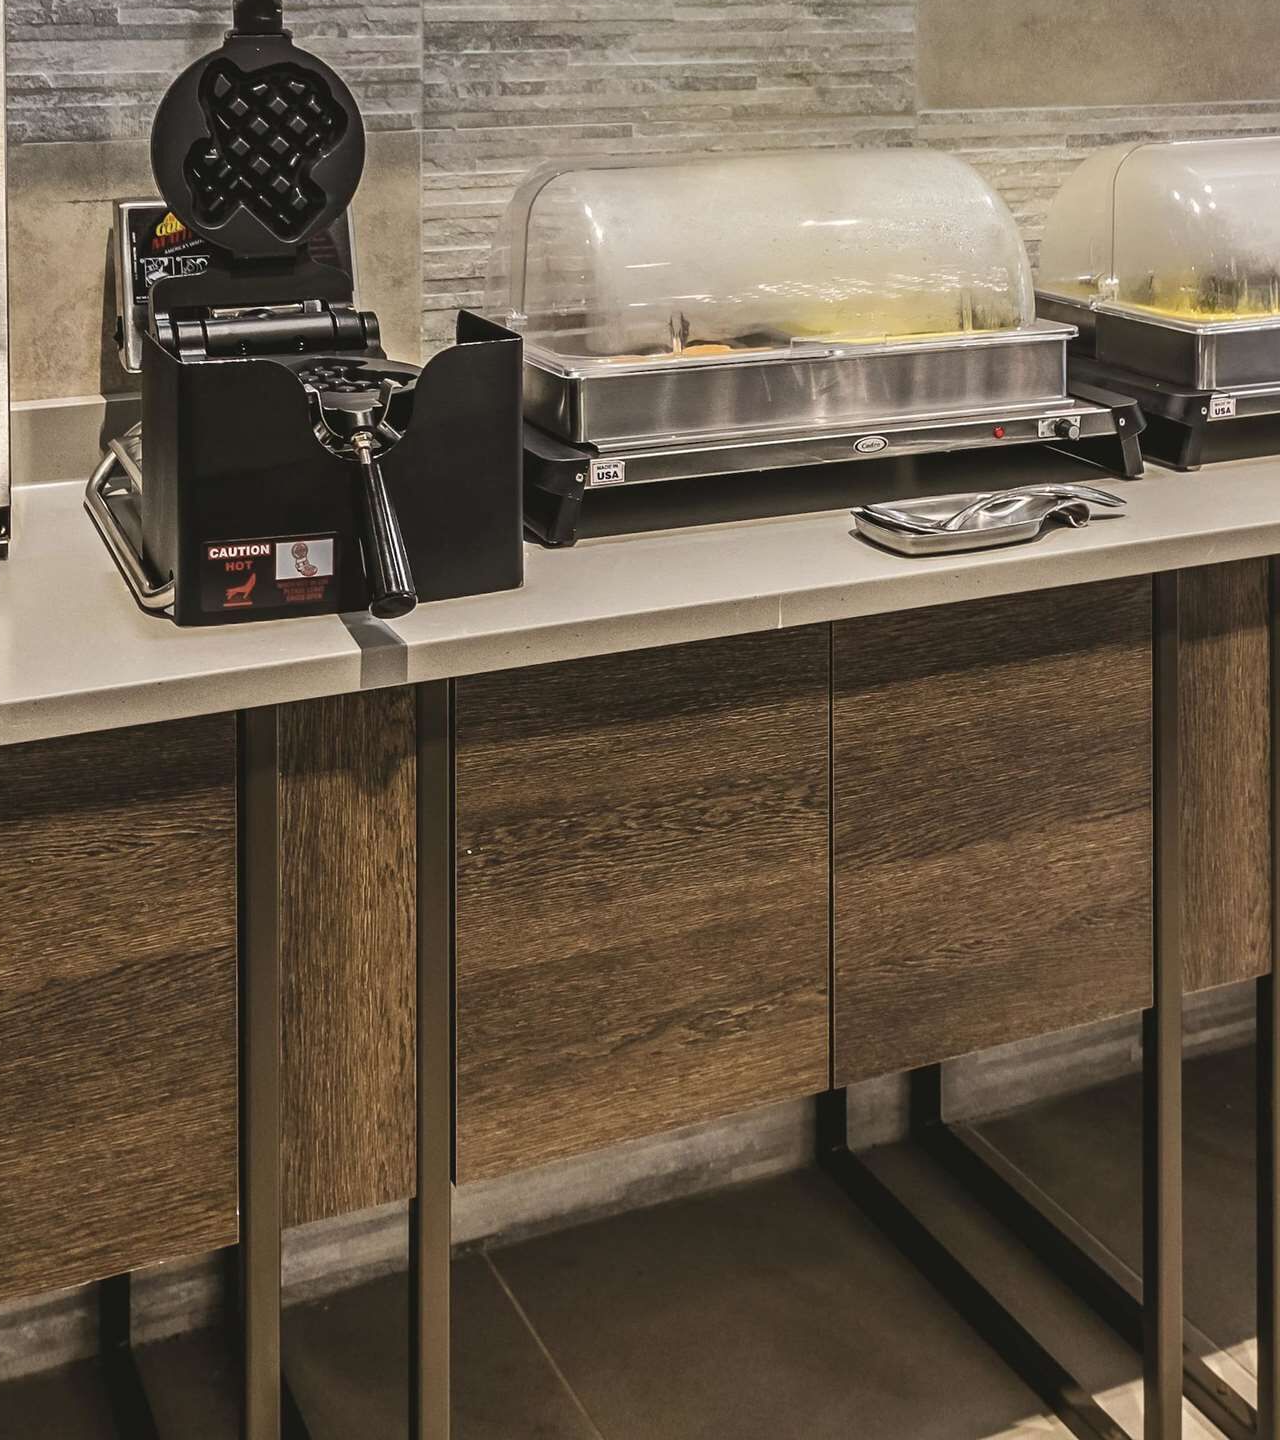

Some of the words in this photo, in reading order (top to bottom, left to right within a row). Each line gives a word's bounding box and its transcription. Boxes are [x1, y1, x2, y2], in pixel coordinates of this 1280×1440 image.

[1214, 406, 1232, 416] USA
[597, 470, 619, 481] USA
[209, 544, 271, 559] CAUTION
[224, 561, 254, 572] HOT
